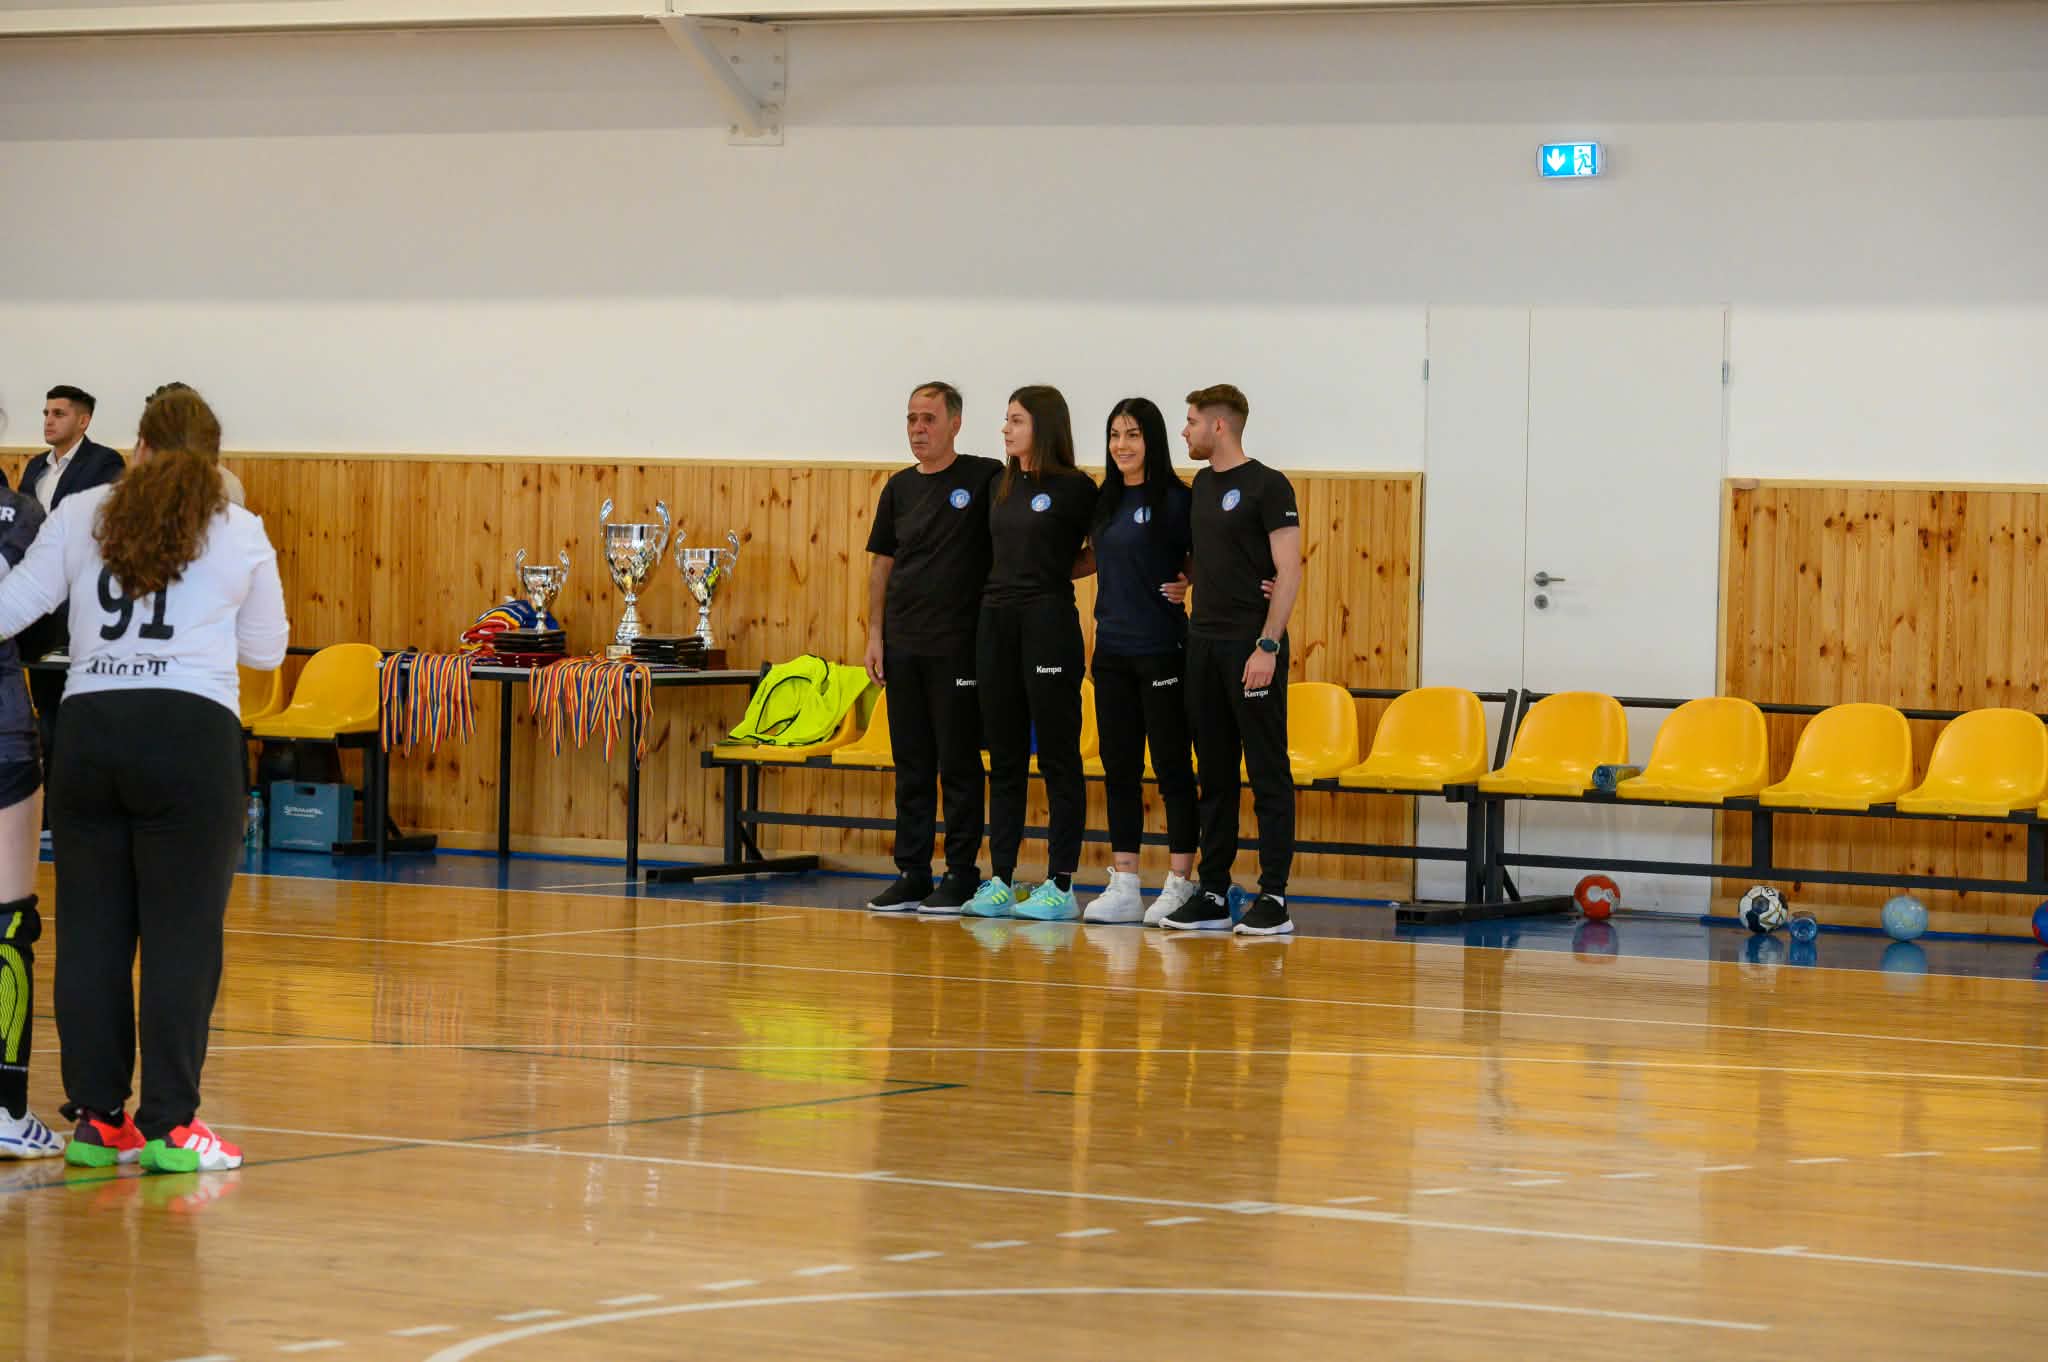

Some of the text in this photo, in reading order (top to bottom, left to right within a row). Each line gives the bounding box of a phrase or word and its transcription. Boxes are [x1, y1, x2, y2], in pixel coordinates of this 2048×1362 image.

[1036, 665, 1062, 676] Kempa
[955, 678, 977, 687] Kemp
[1152, 677, 1179, 688] Kempa
[1244, 689, 1269, 699] Kempa
